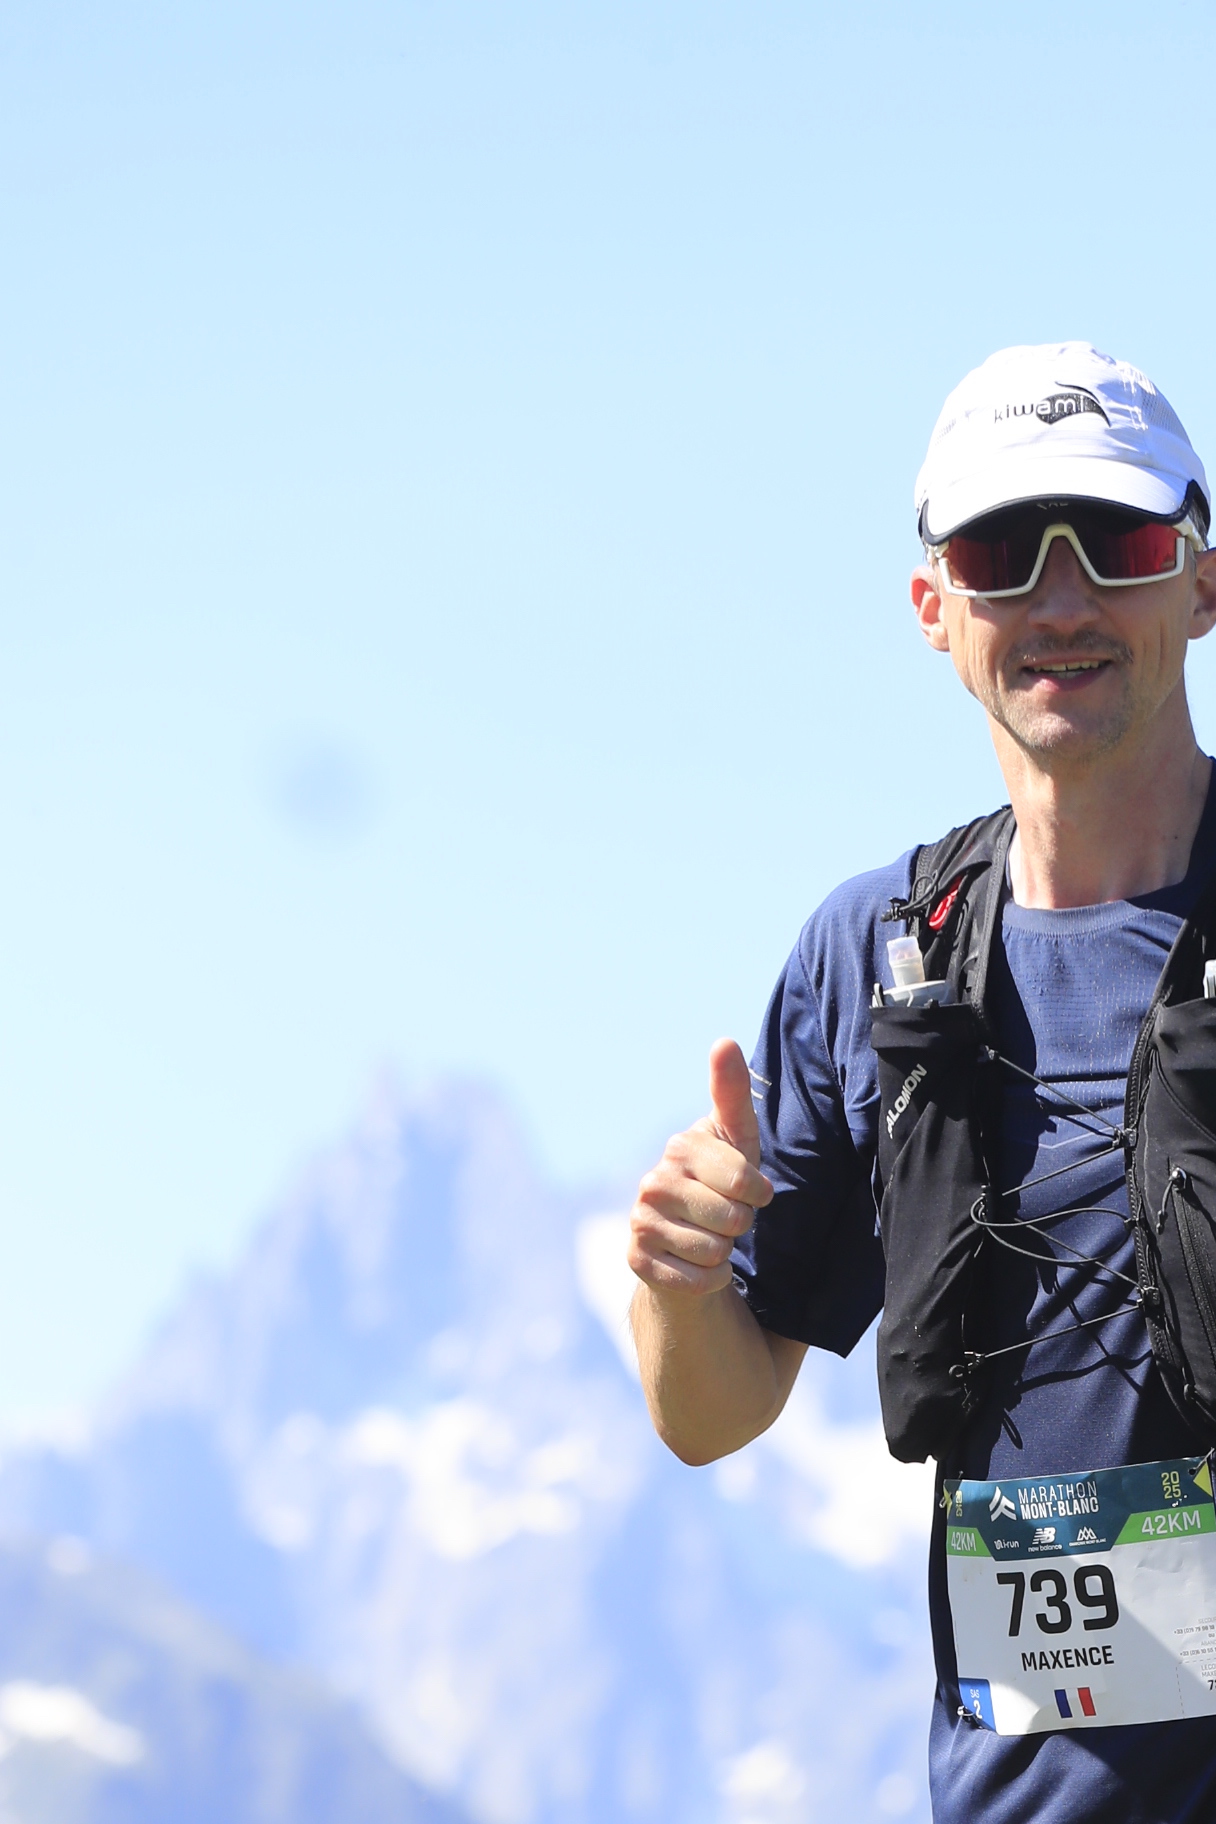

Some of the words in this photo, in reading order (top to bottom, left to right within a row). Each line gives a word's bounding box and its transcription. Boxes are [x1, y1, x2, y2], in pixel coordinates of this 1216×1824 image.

[994, 394, 1084, 423] kiwami
[886, 1063, 928, 1139] ALOMON
[1161, 1471, 1180, 1486] 20
[1018, 1481, 1098, 1504] MARATHON
[1163, 1484, 1181, 1499] 25
[1020, 1497, 1099, 1520] MONT-BLANC
[1141, 1510, 1201, 1536] 42KM
[951, 1531, 977, 1552] 42KM
[1028, 1545, 1039, 1553] new
[1040, 1544, 1063, 1552] balance
[996, 1564, 1119, 1637] 739
[1021, 1645, 1115, 1671] MAXENCE
[970, 1689, 980, 1698] SAS
[973, 1699, 983, 1719] 2
